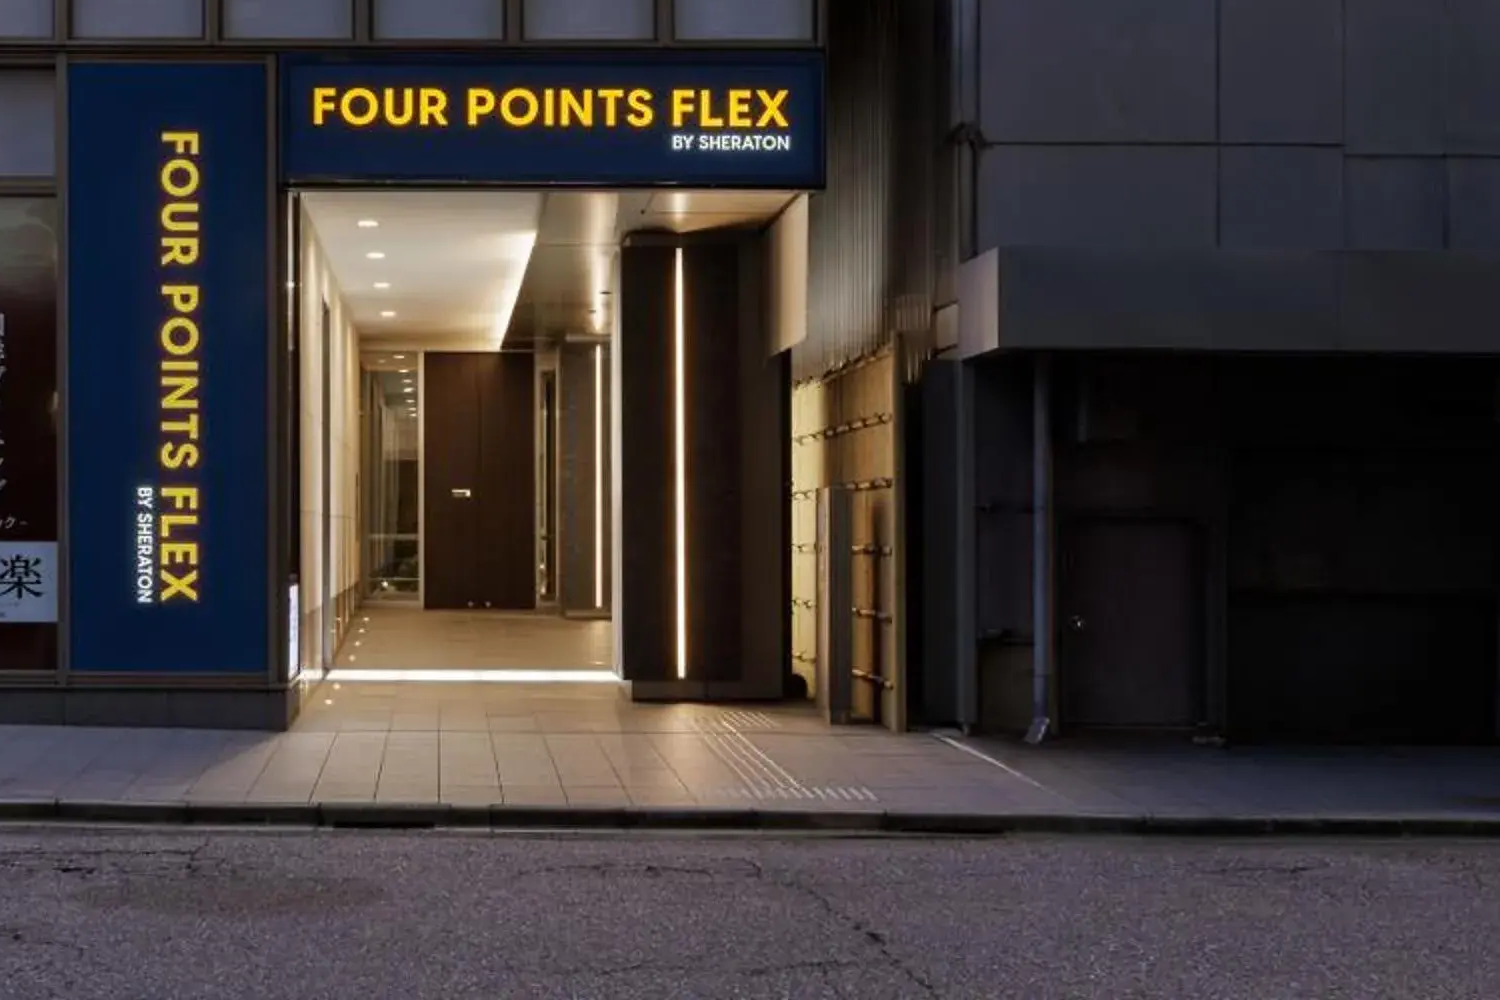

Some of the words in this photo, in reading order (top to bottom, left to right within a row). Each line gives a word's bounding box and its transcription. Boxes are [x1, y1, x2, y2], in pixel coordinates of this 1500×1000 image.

[313, 87, 448, 126] FOUR
[467, 88, 653, 127] POINTS
[672, 89, 789, 127] FLEX
[672, 135, 693, 150] BY
[698, 135, 790, 151] SHERATON
[161, 131, 199, 266] FOUR
[161, 285, 199, 469] POINTS
[137, 486, 153, 507] BY
[137, 513, 153, 603] SHERATON
[160, 487, 198, 602] FLEX
